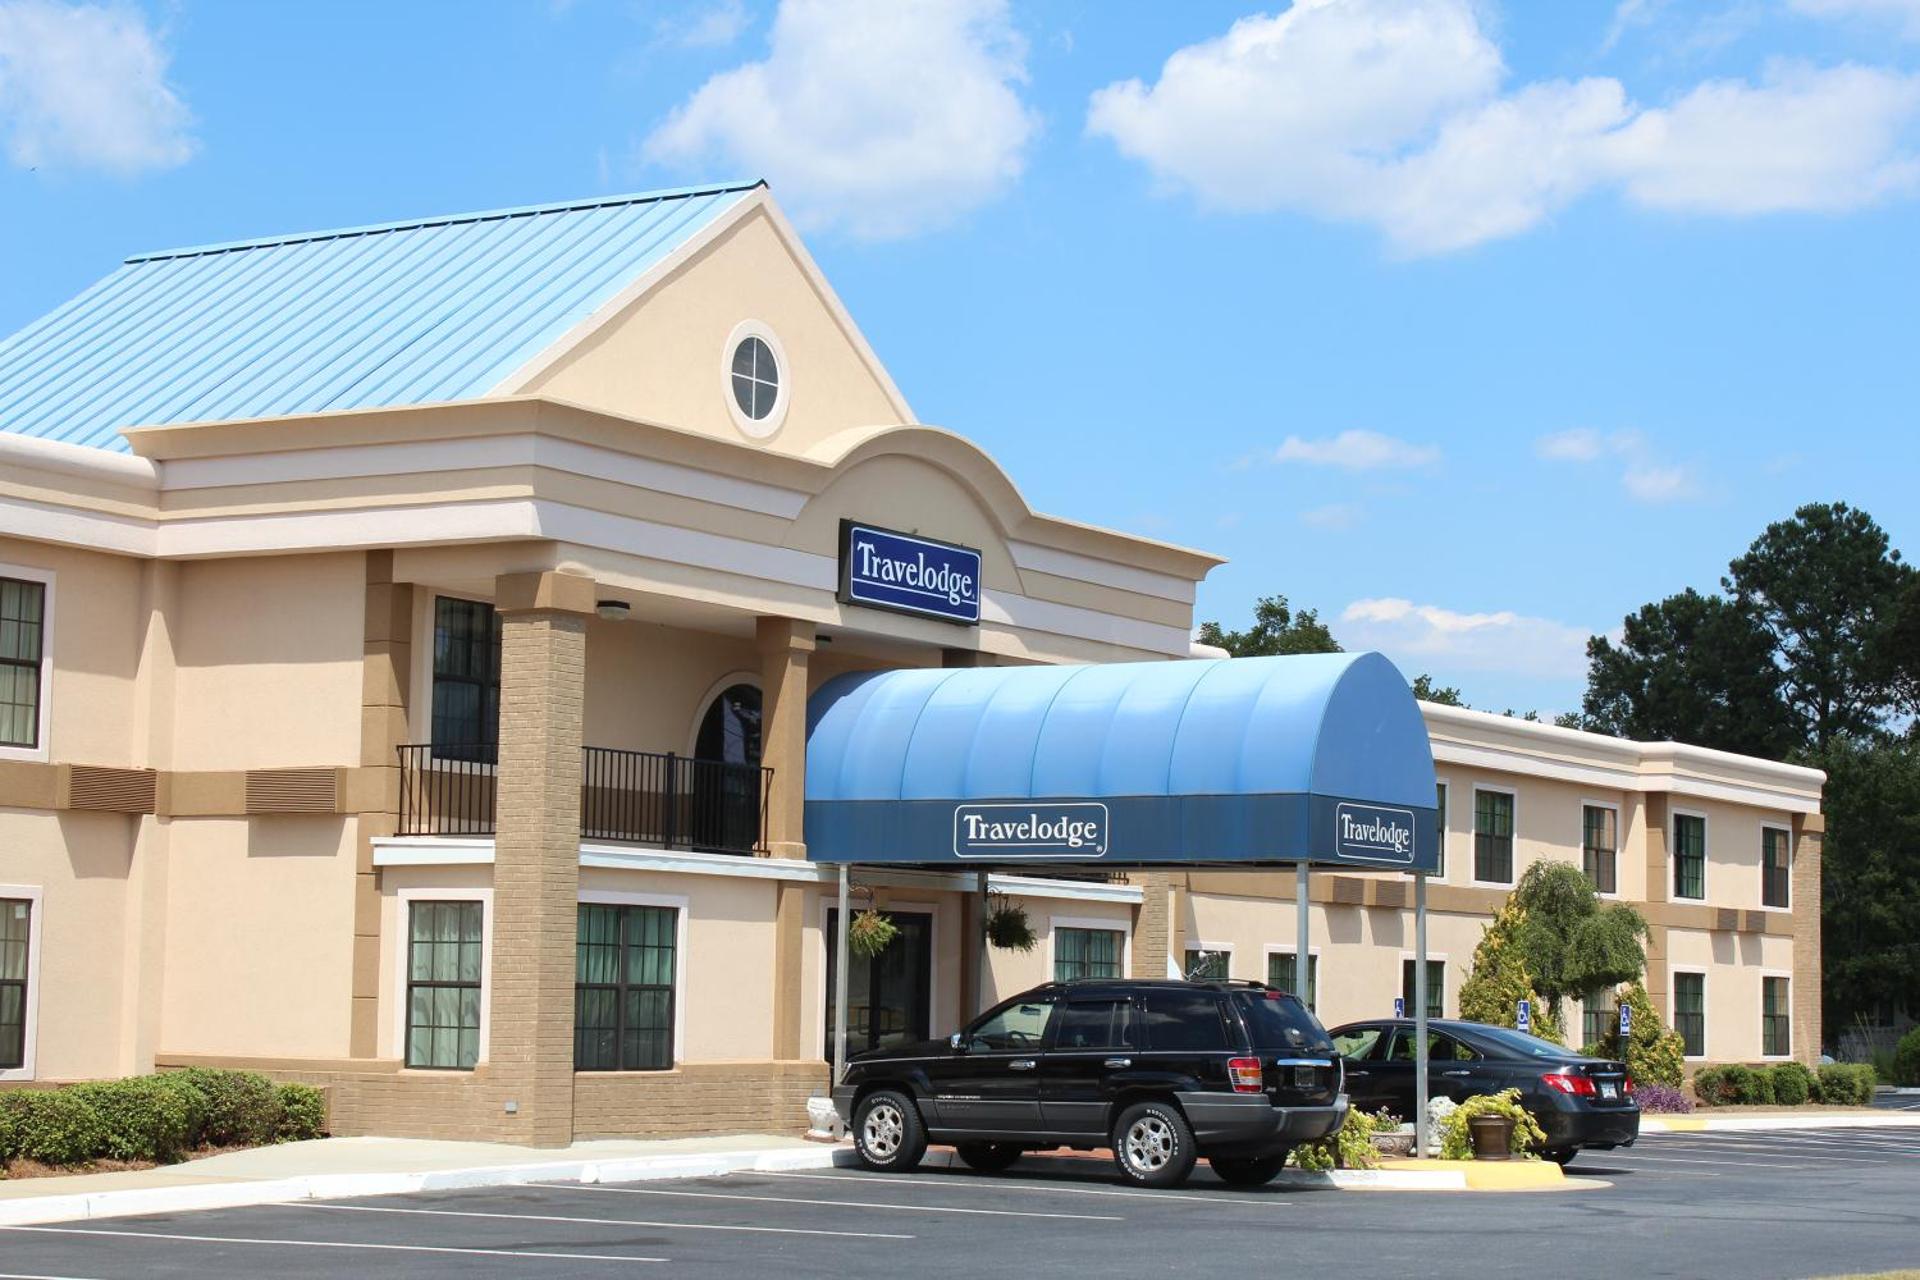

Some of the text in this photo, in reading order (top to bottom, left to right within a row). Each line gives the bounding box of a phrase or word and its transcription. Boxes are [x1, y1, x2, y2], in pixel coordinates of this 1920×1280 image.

[857, 541, 972, 606] Travelodge
[963, 813, 1097, 847] Travelodge
[1341, 813, 1409, 853] Travelodge
